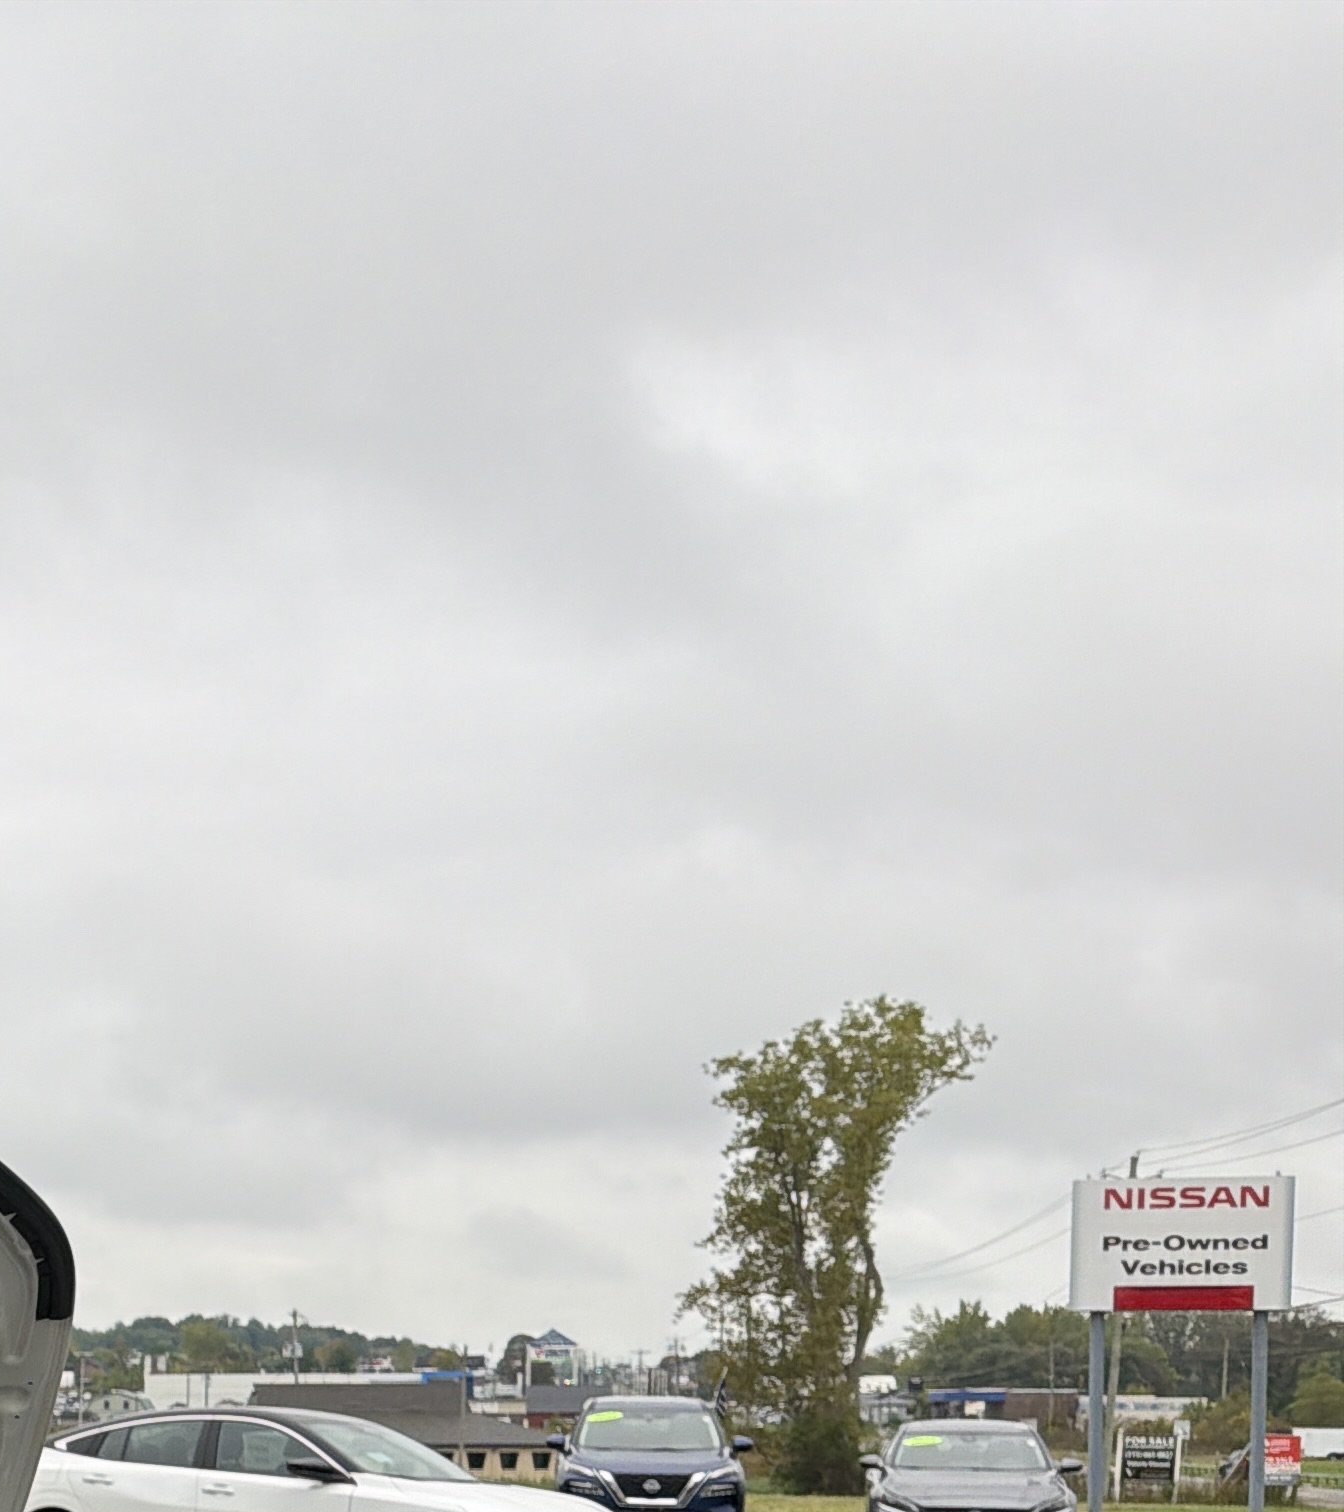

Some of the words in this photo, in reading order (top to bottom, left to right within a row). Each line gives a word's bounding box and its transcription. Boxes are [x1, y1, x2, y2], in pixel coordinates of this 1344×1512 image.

[1103, 1185, 1270, 1210] NISSAN
[1102, 1234, 1269, 1251] Pre-Owned
[1121, 1259, 1249, 1276] Vehicles
